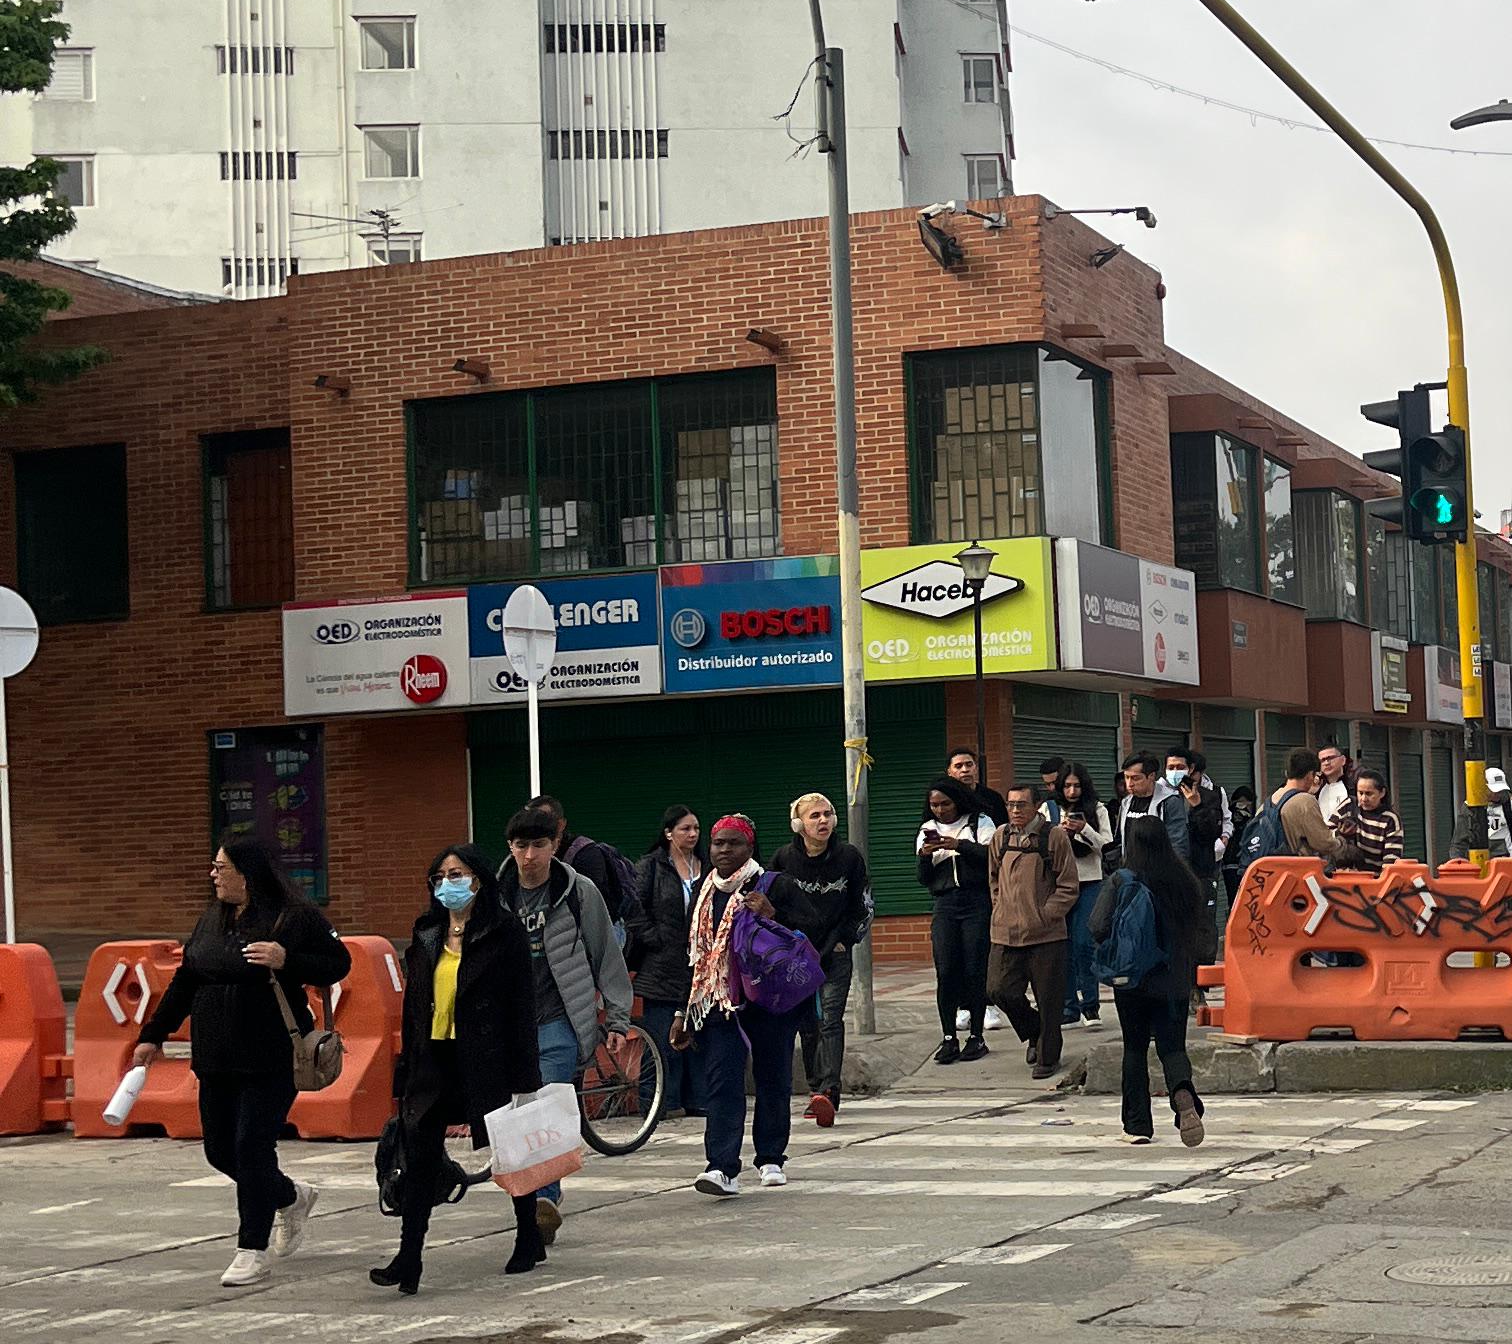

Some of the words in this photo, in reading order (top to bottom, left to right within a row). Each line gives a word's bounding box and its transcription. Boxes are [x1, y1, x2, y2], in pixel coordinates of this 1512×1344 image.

[364, 613, 442, 630] ORGANIZACIÓN
[720, 605, 831, 639] BOSCH
[317, 623, 352, 642] OED
[364, 628, 442, 641] ELECTRODOMÉSTICA
[925, 628, 1032, 649] ORGANZACIÓN
[868, 639, 909, 659] OED
[550, 657, 639, 677] ORGANIZACIÓN
[678, 654, 758, 671] Distribuidor
[761, 649, 833, 665] autorizado
[405, 655, 440, 695] Rheem
[550, 674, 640, 690] ELECTRODOMÉSTICA
